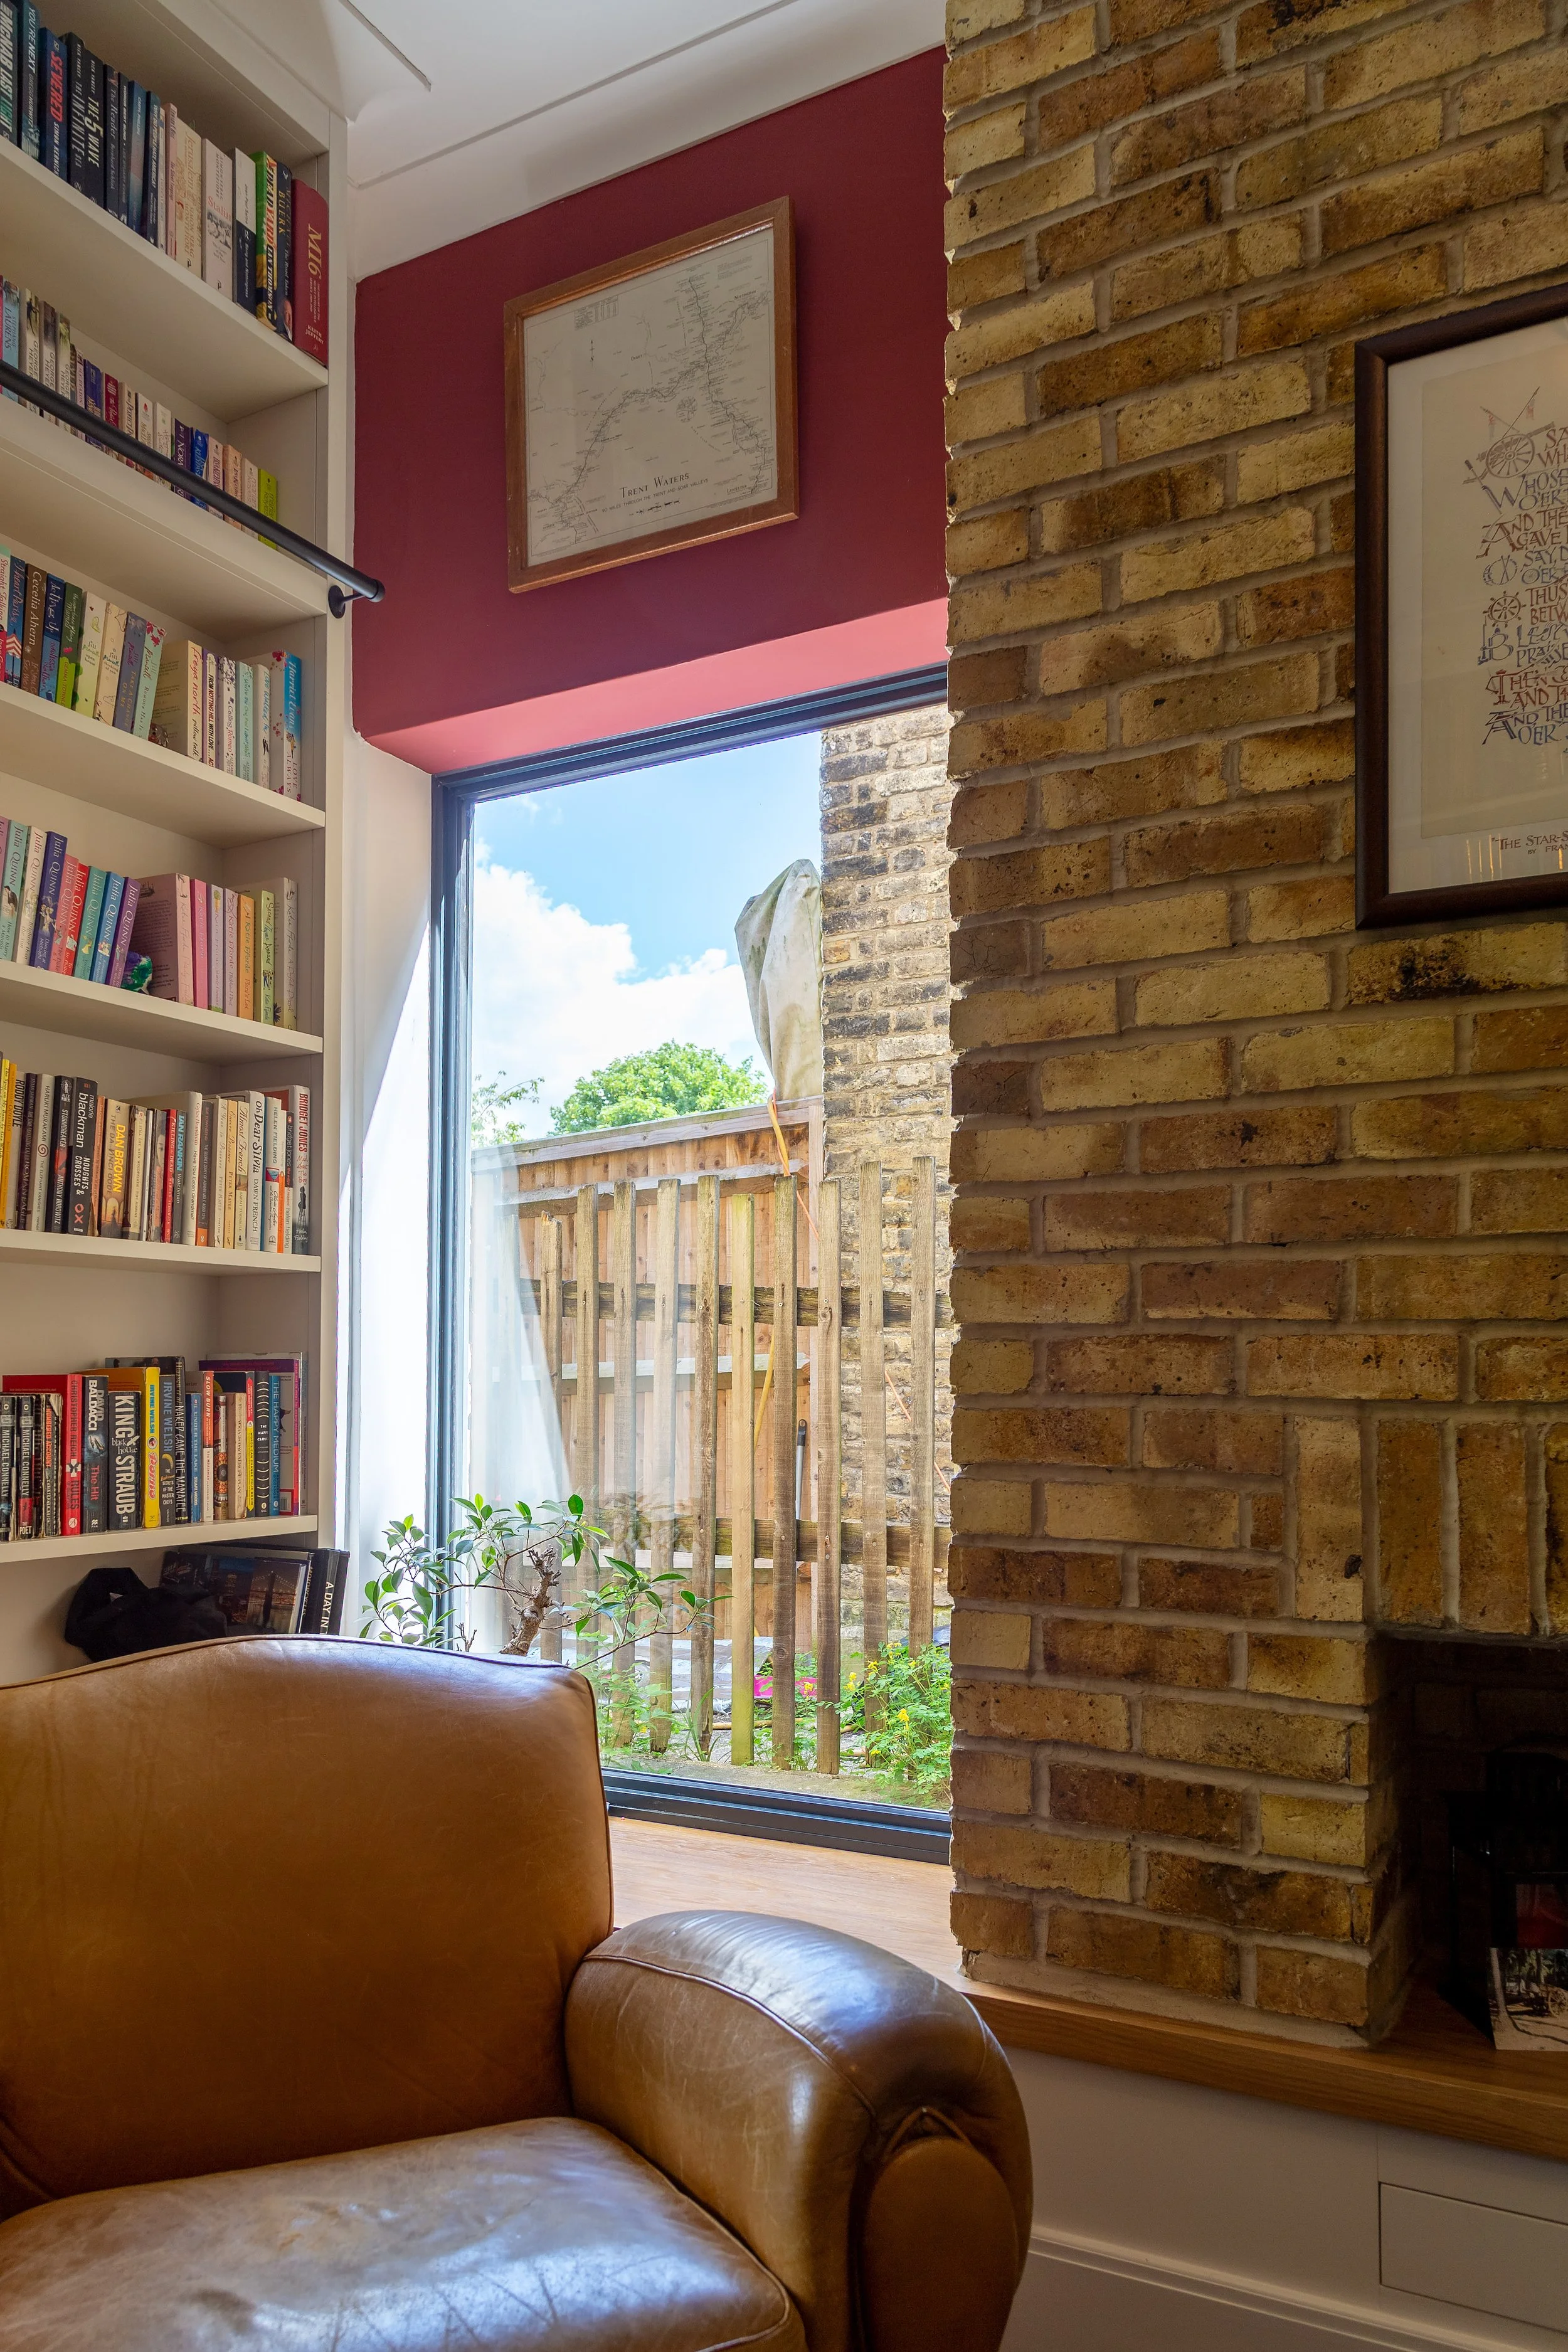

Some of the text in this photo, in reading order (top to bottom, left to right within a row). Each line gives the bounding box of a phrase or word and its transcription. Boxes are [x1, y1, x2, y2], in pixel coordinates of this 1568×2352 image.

[28, 7, 36, 43] YOU'RE
[0, 65, 13, 132] LAST LIGHT
[50, 51, 63, 123] SEVERED
[83, 96, 103, 168] THE 5 WAVE
[109, 102, 120, 140] Reader
[206, 196, 231, 221] Stalin
[308, 223, 322, 280] MI6
[307, 324, 322, 337] KEITH
[619, 473, 689, 498] TRENT WATERS
[623, 497, 642, 506] THROUGH
[690, 478, 708, 487] VALLEYS
[1518, 489, 1567, 511] O'ER
[1517, 527, 1562, 550] GAVE
[1520, 544, 1557, 572] SAY,
[29, 571, 42, 645] Cecelia Ahern
[191, 647, 201, 716] freya north
[288, 661, 297, 729] Harriet Evans
[1510, 690, 1549, 708] AND
[191, 718, 199, 739] pillow
[1518, 722, 1562, 746] O'ER
[10, 825, 24, 886] Julia QUINN
[30, 831, 43, 891] Julia QUINN
[49, 835, 64, 896] Julia QUINN
[60, 860, 77, 926] Julia QUINN
[68, 867, 87, 933] Julia QUINN
[86, 873, 103, 936] Julia QUINN
[103, 878, 121, 940] Julia QUINN
[120, 883, 138, 946] Julia QUINN
[13, 1079, 25, 1128] RODDY DOYLE
[60, 1109, 68, 1147] STORMBREAKER
[76, 1093, 88, 1148] blackman
[298, 1093, 308, 1153] BRIDGET JONES
[113, 1123, 125, 1194] DAN BROWN
[238, 1107, 248, 1175] Almost French
[252, 1100, 263, 1173] Oh Dear Silvia
[23, 1162, 31, 1192] ROMAN
[74, 1155, 82, 1187] CROSSES
[82, 1155, 90, 1190] NOUGHTS
[55, 1196, 63, 1224] HOROWITZ
[88, 1380, 97, 1431] BALDACCI
[97, 1389, 105, 1422] DAVID
[115, 1395, 134, 1439] KING
[163, 1382, 173, 1452] IRVINE WELSH
[1, 1429, 9, 1497] MICHAEL CONNELLY
[21, 1429, 30, 1496] MICHAEL CONNELLY
[112, 1438, 127, 1447] black
[117, 1445, 138, 1456] house
[175, 1406, 186, 1513] NAKED CAME THE MANATEE
[70, 1480, 80, 1510] RULES
[90, 1465, 100, 1501] The Hit
[115, 1454, 135, 1515] STRAUB
[148, 1451, 157, 1500] Porno
[19, 1526, 32, 1535] POET
[320, 1581, 334, 1628] A DAY IN
